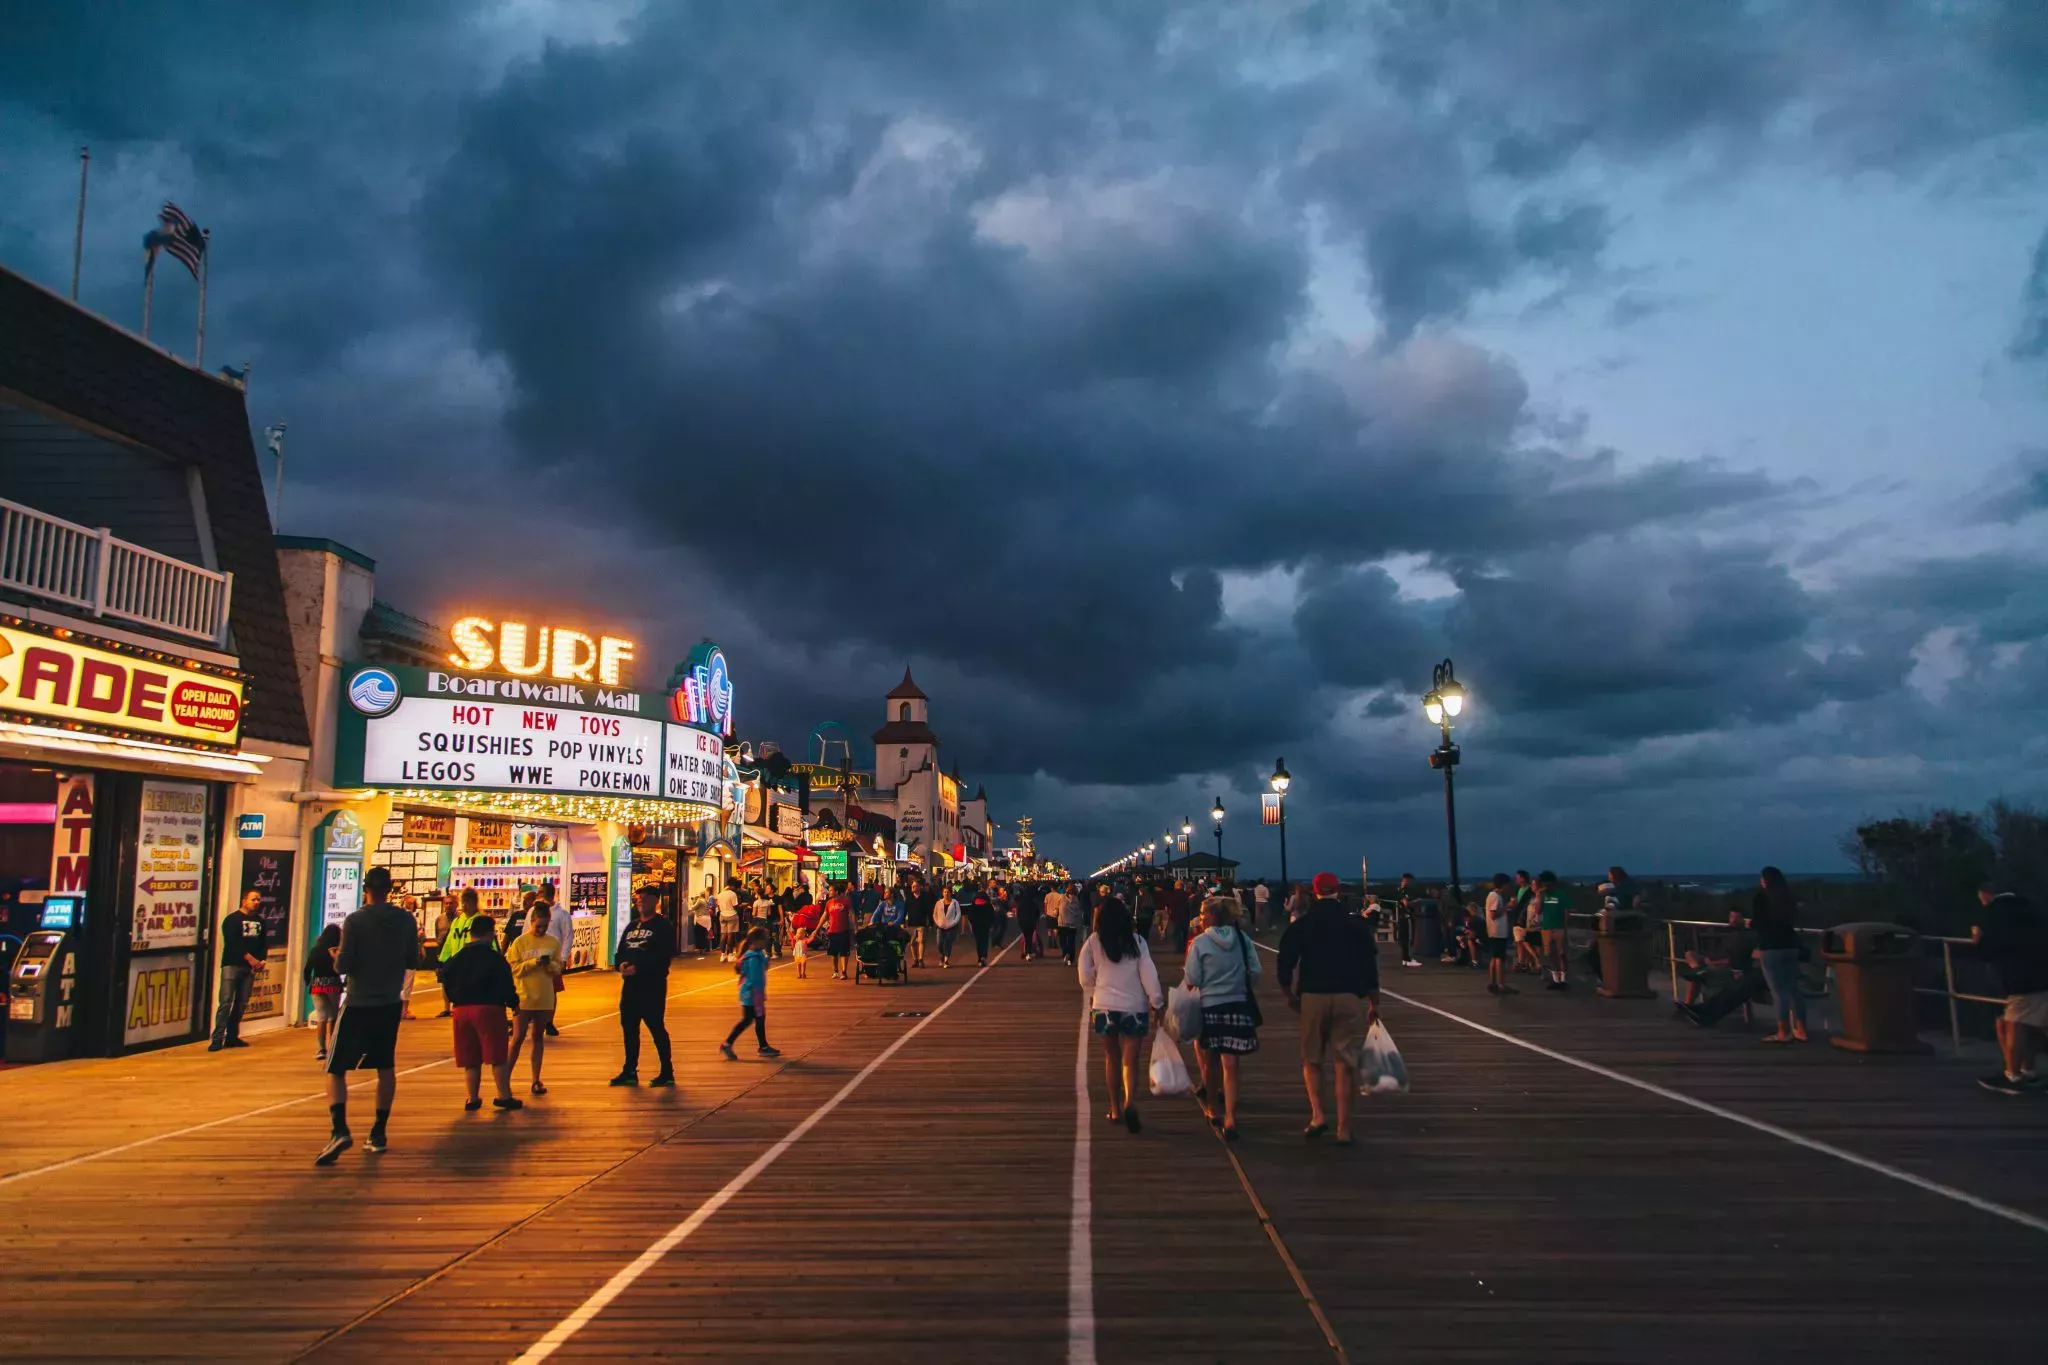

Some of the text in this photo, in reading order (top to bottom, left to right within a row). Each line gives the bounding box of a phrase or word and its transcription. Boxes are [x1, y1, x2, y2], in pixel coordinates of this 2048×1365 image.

[449, 617, 633, 685] SURF
[181, 688, 232, 705] OPEN DAILY
[428, 672, 640, 712] Boardwalk Mall
[174, 704, 235, 720] YEAR AROUND
[453, 705, 620, 737] HOT NEW TOYS
[419, 732, 643, 766] SQUISHIES POP VINYLS
[697, 734, 706, 751] ICE
[670, 753, 698, 773] WATER
[702, 759, 715, 776] SODA
[402, 761, 650, 792] LEGOS WWE POKEMON
[670, 778, 687, 795] ONE
[692, 781, 707, 798] STOP
[143, 789, 204, 813] RENTALS
[55, 780, 93, 892] ATM
[241, 822, 262, 831] ATM
[479, 820, 503, 837] RELAX
[332, 828, 358, 849] Surf
[327, 867, 359, 881] TOP TEN
[150, 881, 193, 890] REAR OF
[46, 905, 71, 914] ATM
[152, 902, 193, 915] JILLY'S
[56, 952, 76, 1028] ATM
[128, 967, 190, 1029] ATM
